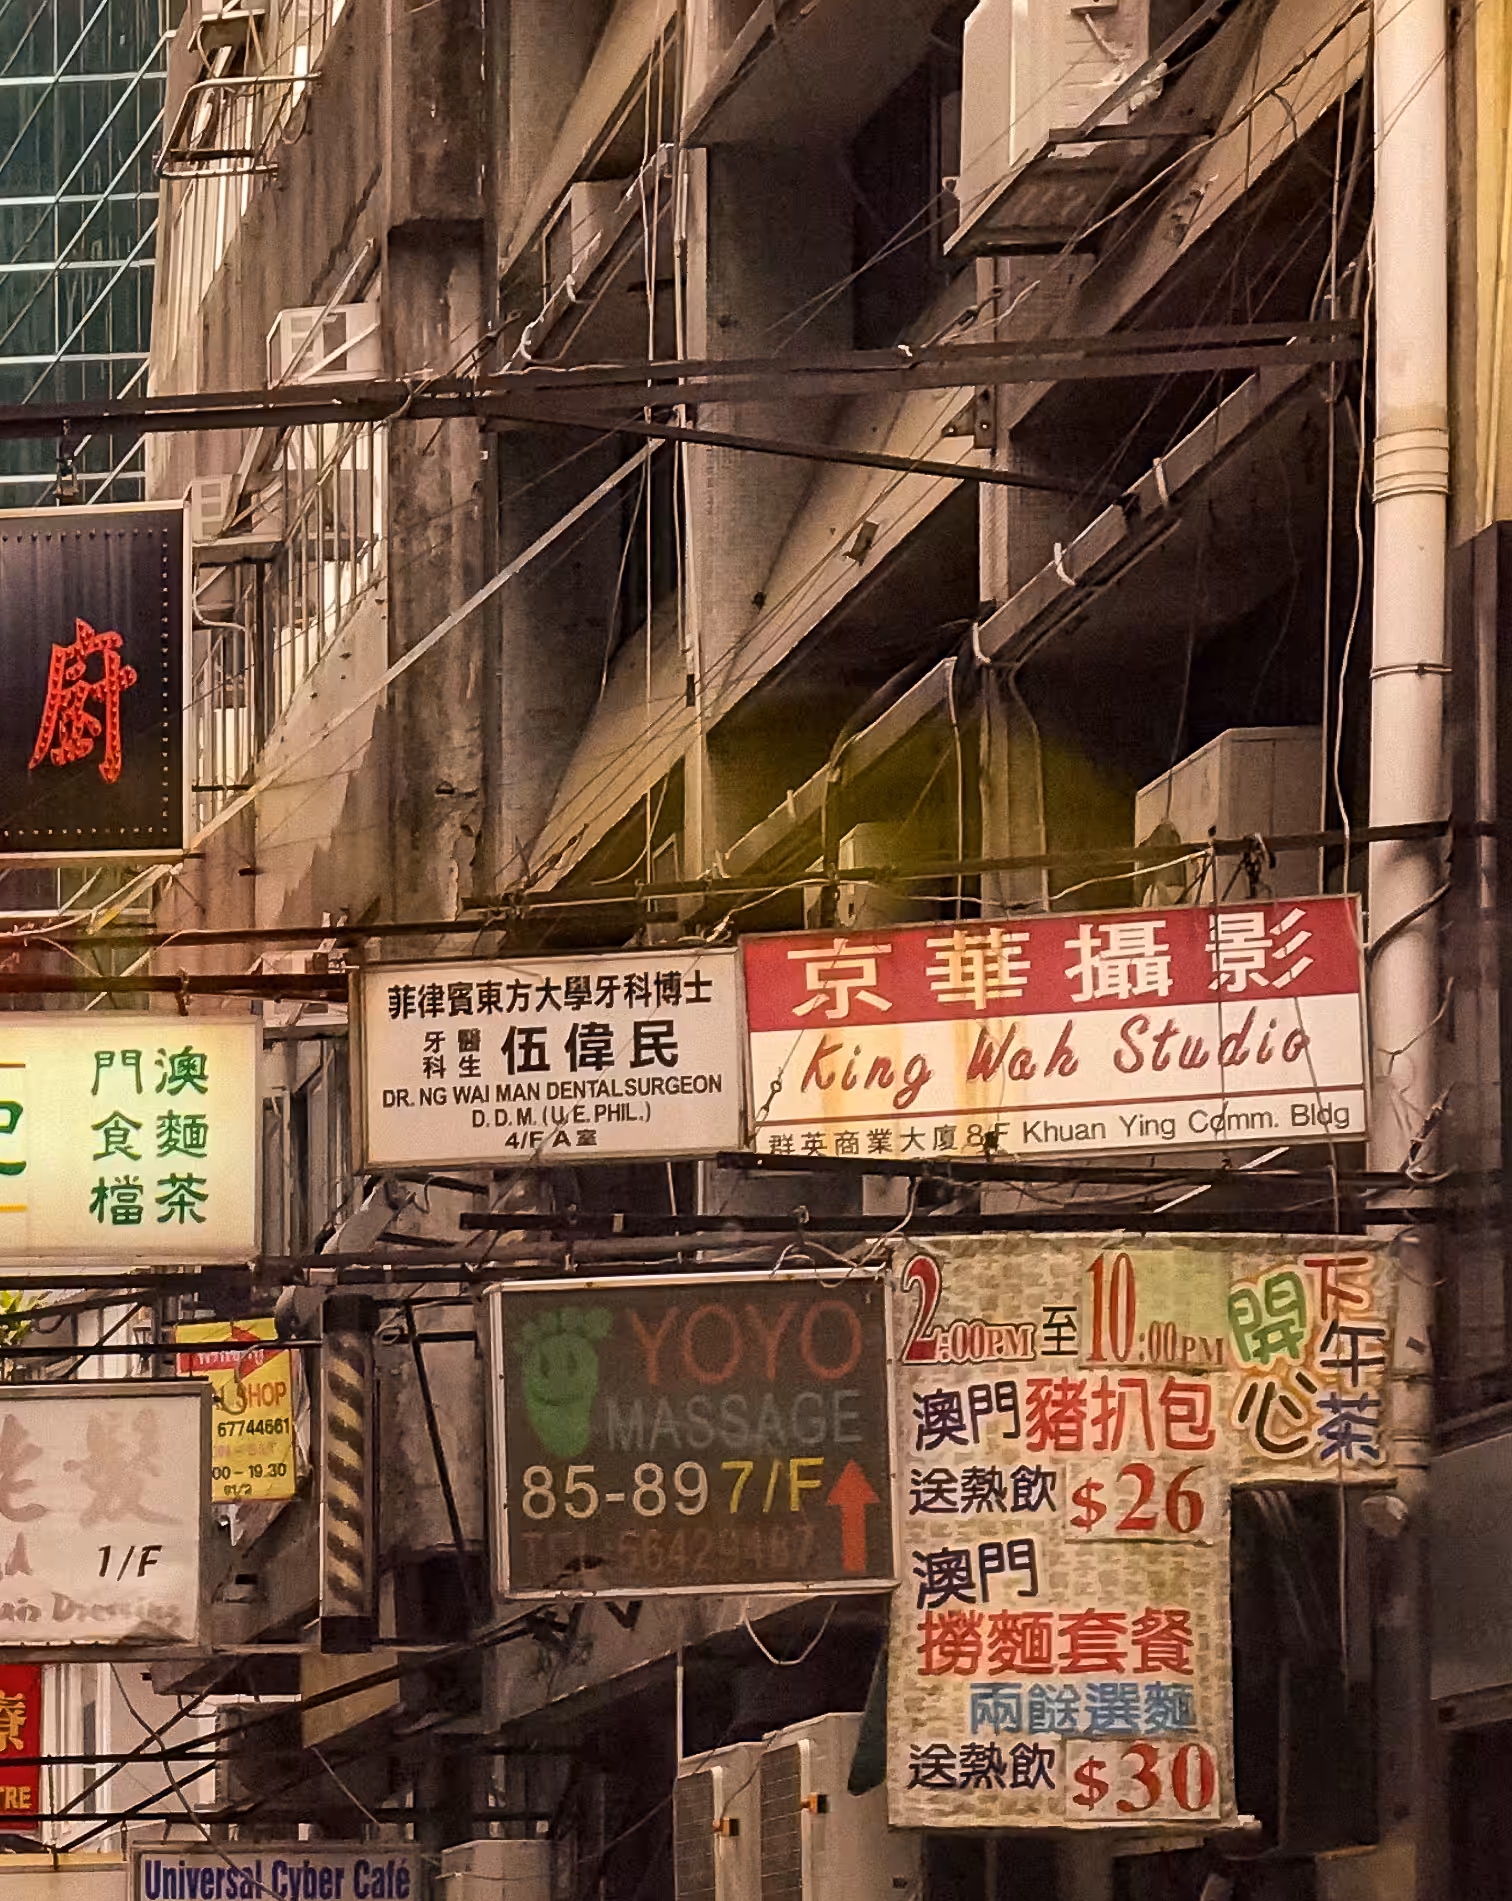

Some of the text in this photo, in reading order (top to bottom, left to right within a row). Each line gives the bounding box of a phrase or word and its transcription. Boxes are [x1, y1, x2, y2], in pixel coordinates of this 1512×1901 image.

[788, 908, 1313, 1020] 京華攝影
[388, 969, 713, 1020] 菲律賓東方大學牙科博士
[801, 1006, 1311, 1109] King Wah Studio
[383, 1089, 415, 1108] DR.
[420, 1086, 447, 1105] NG
[452, 1084, 489, 1103] WAI
[496, 1081, 540, 1101] MAN
[1023, 1116, 1106, 1144] Khuan
[1119, 1114, 1175, 1141] Ying
[1188, 1109, 1279, 1134] Comm.
[1290, 1103, 1350, 1130] Bldg
[628, 1300, 863, 1386] YOYO
[1040, 1305, 1079, 1356] 至
[606, 1388, 865, 1452] MASSAGE
[1070, 1461, 1205, 1534] $26
[99, 1544, 163, 1582] 1/F
[1072, 1742, 1216, 1813] $30
[144, 1859, 263, 1901] Universal
[353, 1856, 411, 1900] Café
